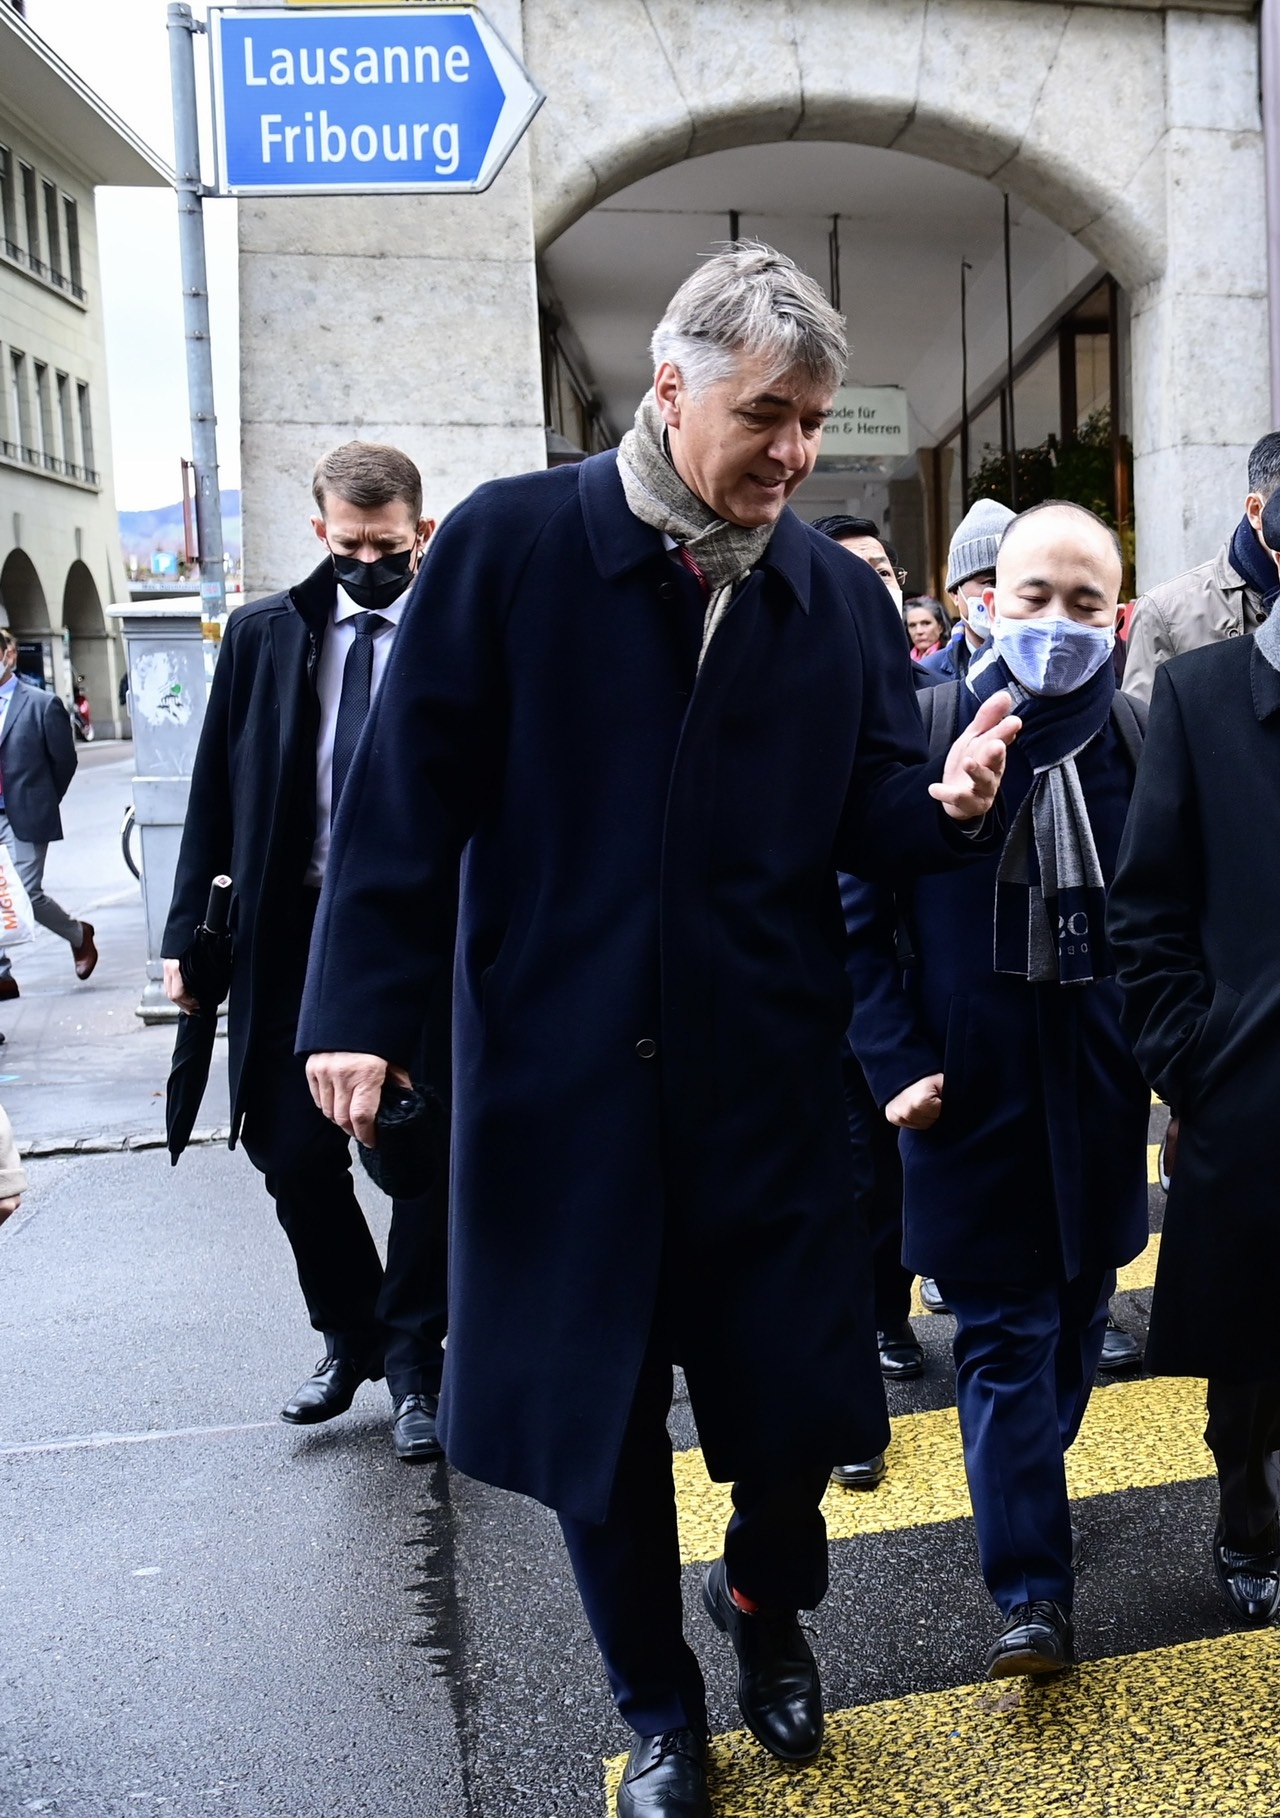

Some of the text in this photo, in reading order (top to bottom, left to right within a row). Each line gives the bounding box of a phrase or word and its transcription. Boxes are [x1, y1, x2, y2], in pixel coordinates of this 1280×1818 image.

[243, 36, 470, 86] Lausanne
[260, 109, 460, 175] Fribourg
[842, 421, 853, 435] &
[857, 422, 902, 436] Herren
[857, 406, 877, 419] für
